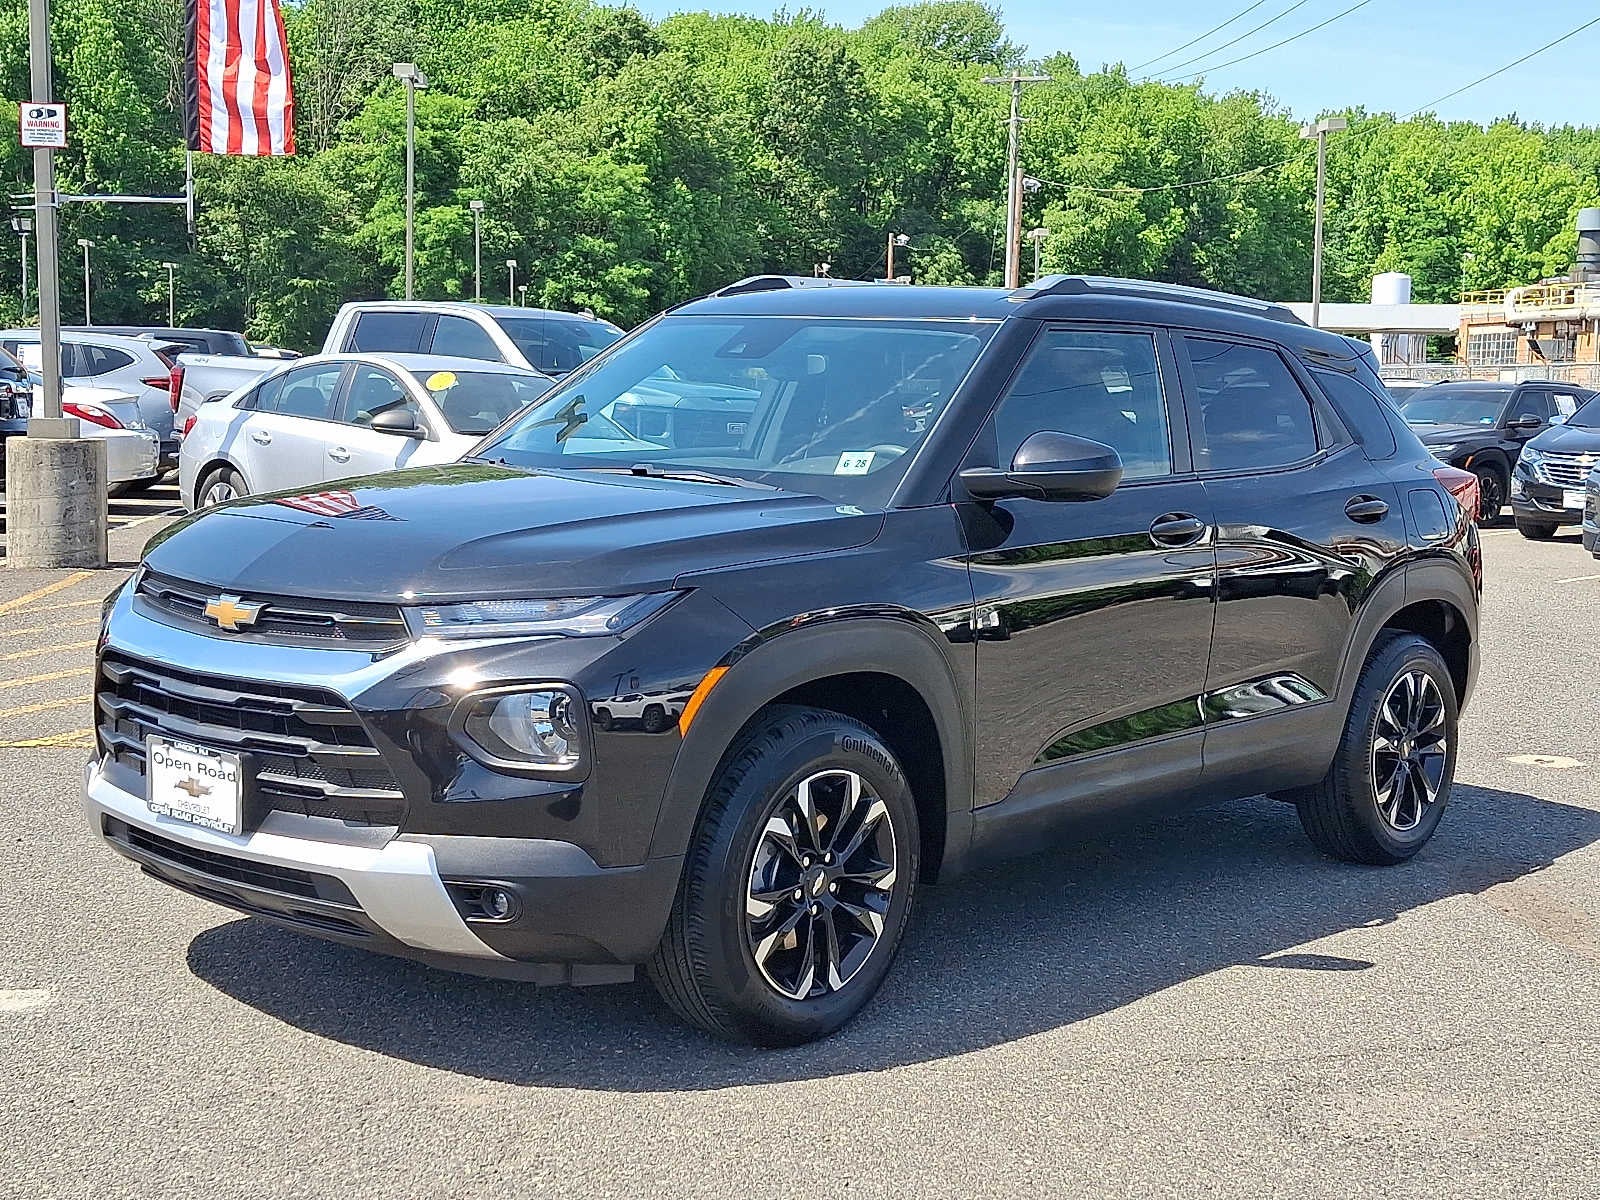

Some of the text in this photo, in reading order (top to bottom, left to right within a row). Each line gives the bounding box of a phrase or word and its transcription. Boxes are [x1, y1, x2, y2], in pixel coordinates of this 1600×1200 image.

[27, 120, 60, 128] WARNING
[854, 459, 867, 468] 28
[153, 751, 237, 783] Open Road
[841, 735, 895, 776] Continental
[150, 802, 171, 816] OPEN
[171, 807, 192, 822] ROAD
[192, 814, 234, 834] CHEVROLET
